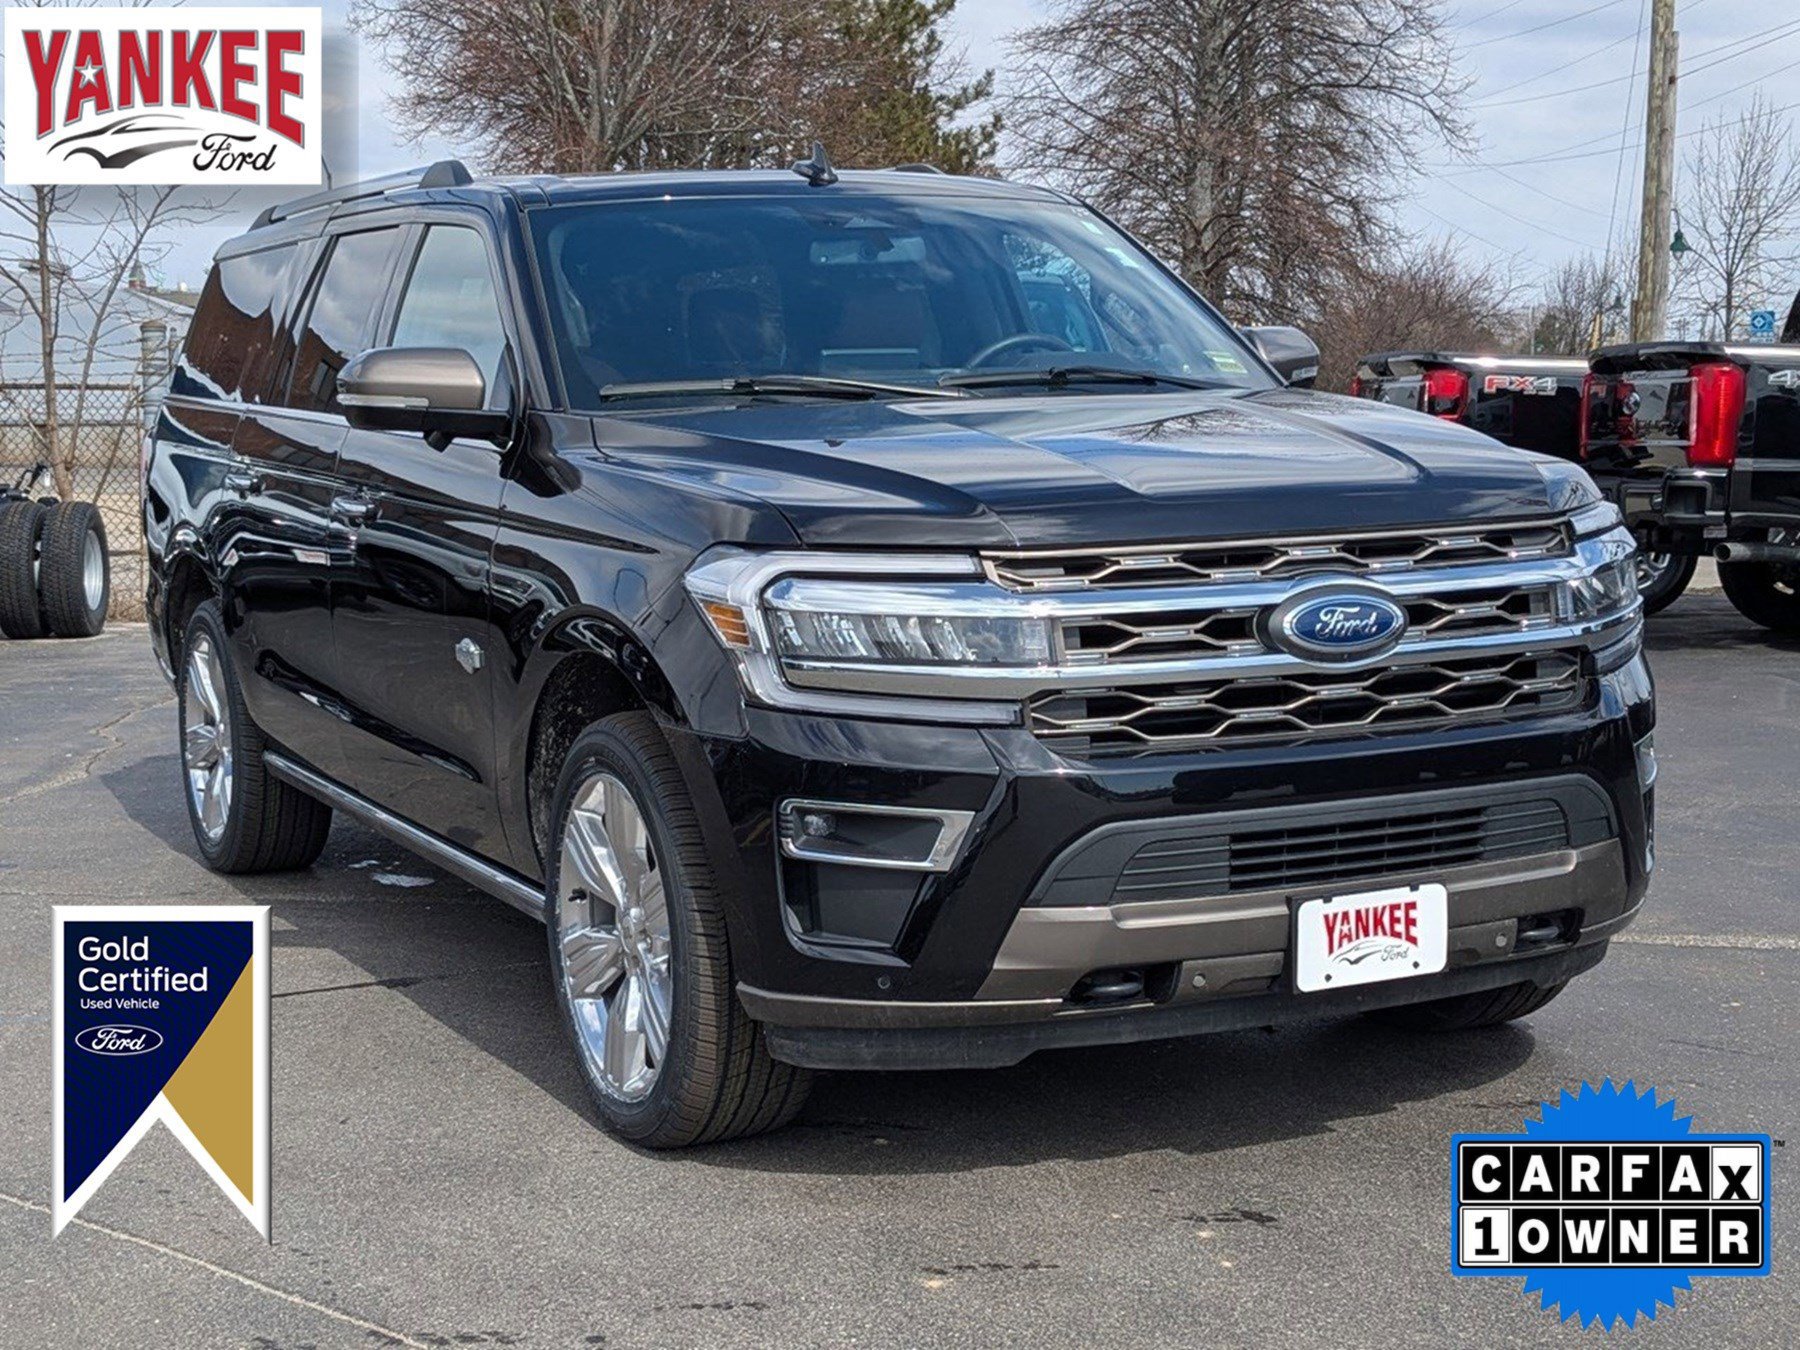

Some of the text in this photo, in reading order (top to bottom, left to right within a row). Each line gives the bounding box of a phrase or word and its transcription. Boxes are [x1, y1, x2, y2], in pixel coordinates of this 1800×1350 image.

[1484, 375, 1557, 395] FX4
[1315, 606, 1378, 638] Ford
[1323, 901, 1418, 956] YANKEE
[1381, 943, 1409, 962] Ford
